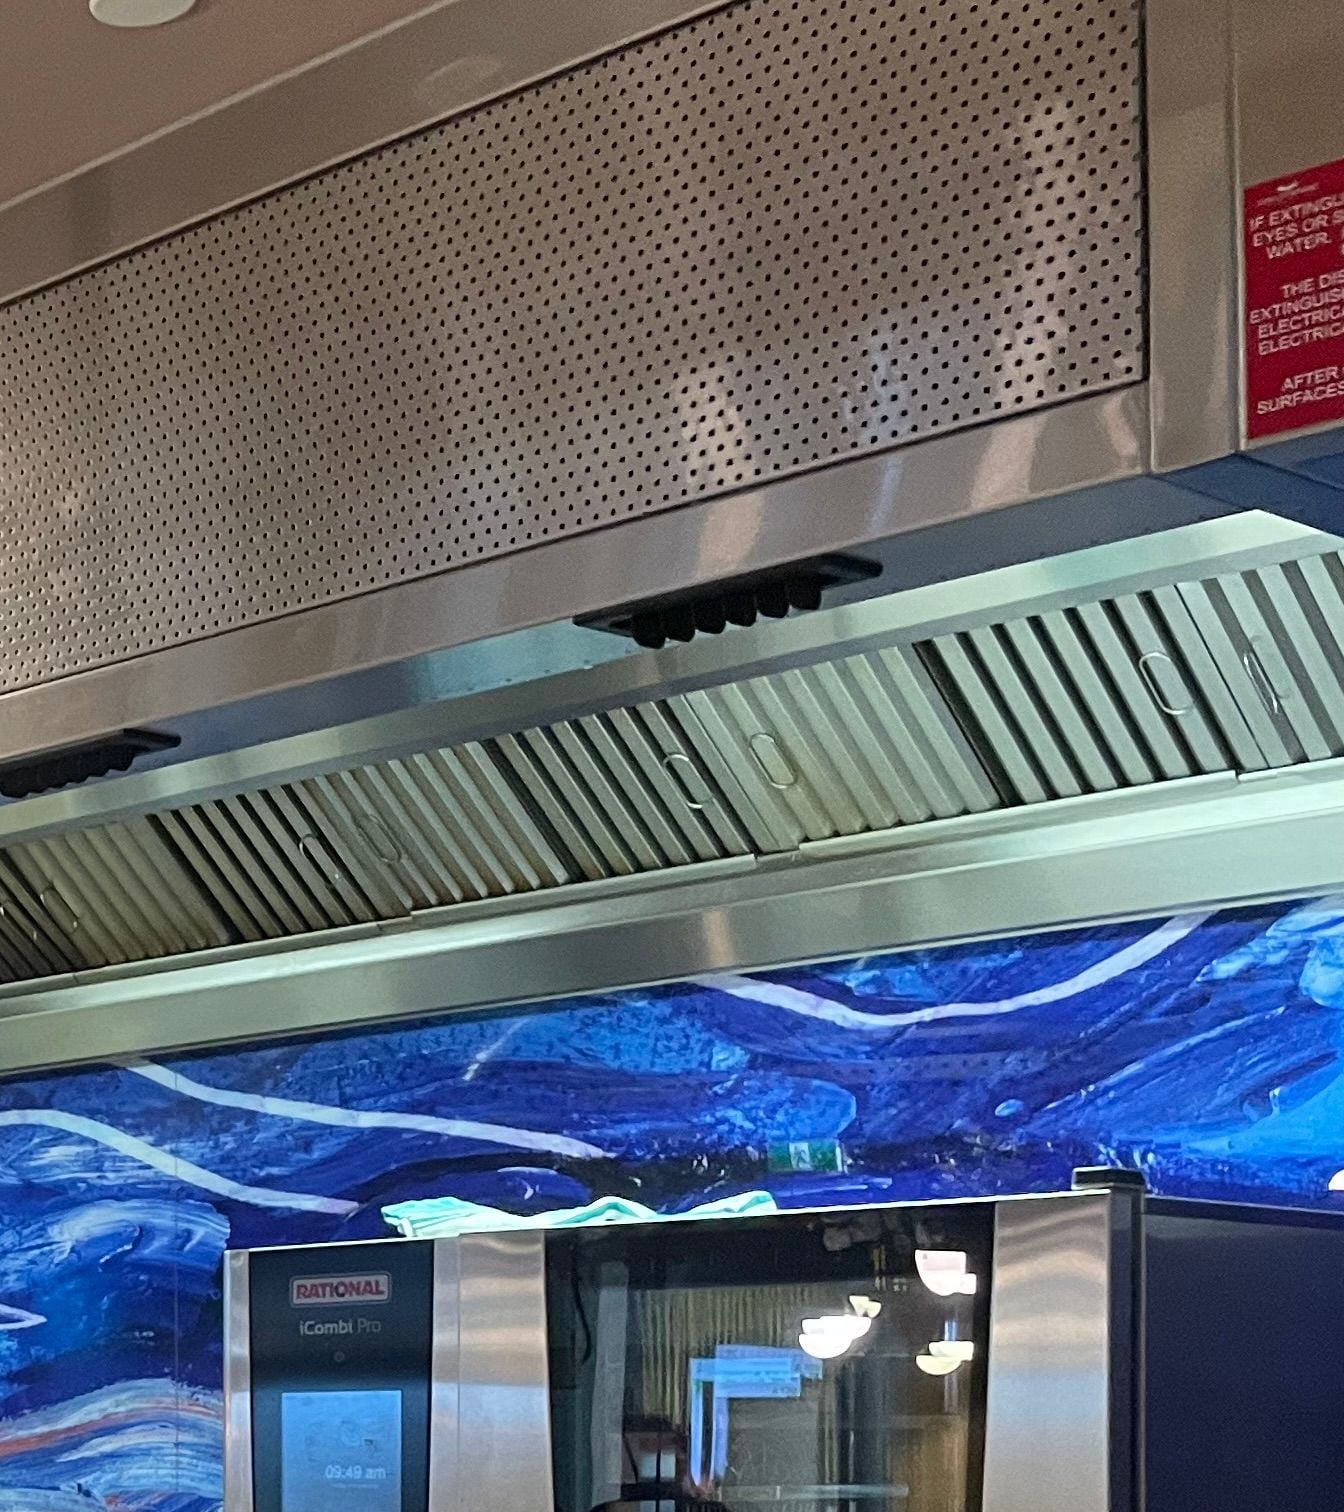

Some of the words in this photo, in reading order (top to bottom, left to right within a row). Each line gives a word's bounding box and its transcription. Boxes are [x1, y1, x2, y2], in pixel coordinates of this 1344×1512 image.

[1249, 215, 1265, 232] IF
[1253, 222, 1299, 247] EYES
[1302, 214, 1329, 232] OR
[1281, 277, 1315, 298] THE
[1281, 366, 1339, 392] AFTER
[296, 1280, 385, 1300] RATIONAL
[299, 1319, 353, 1336] iCombi
[357, 1318, 382, 1334] Pro
[366, 1467, 386, 1479] am
